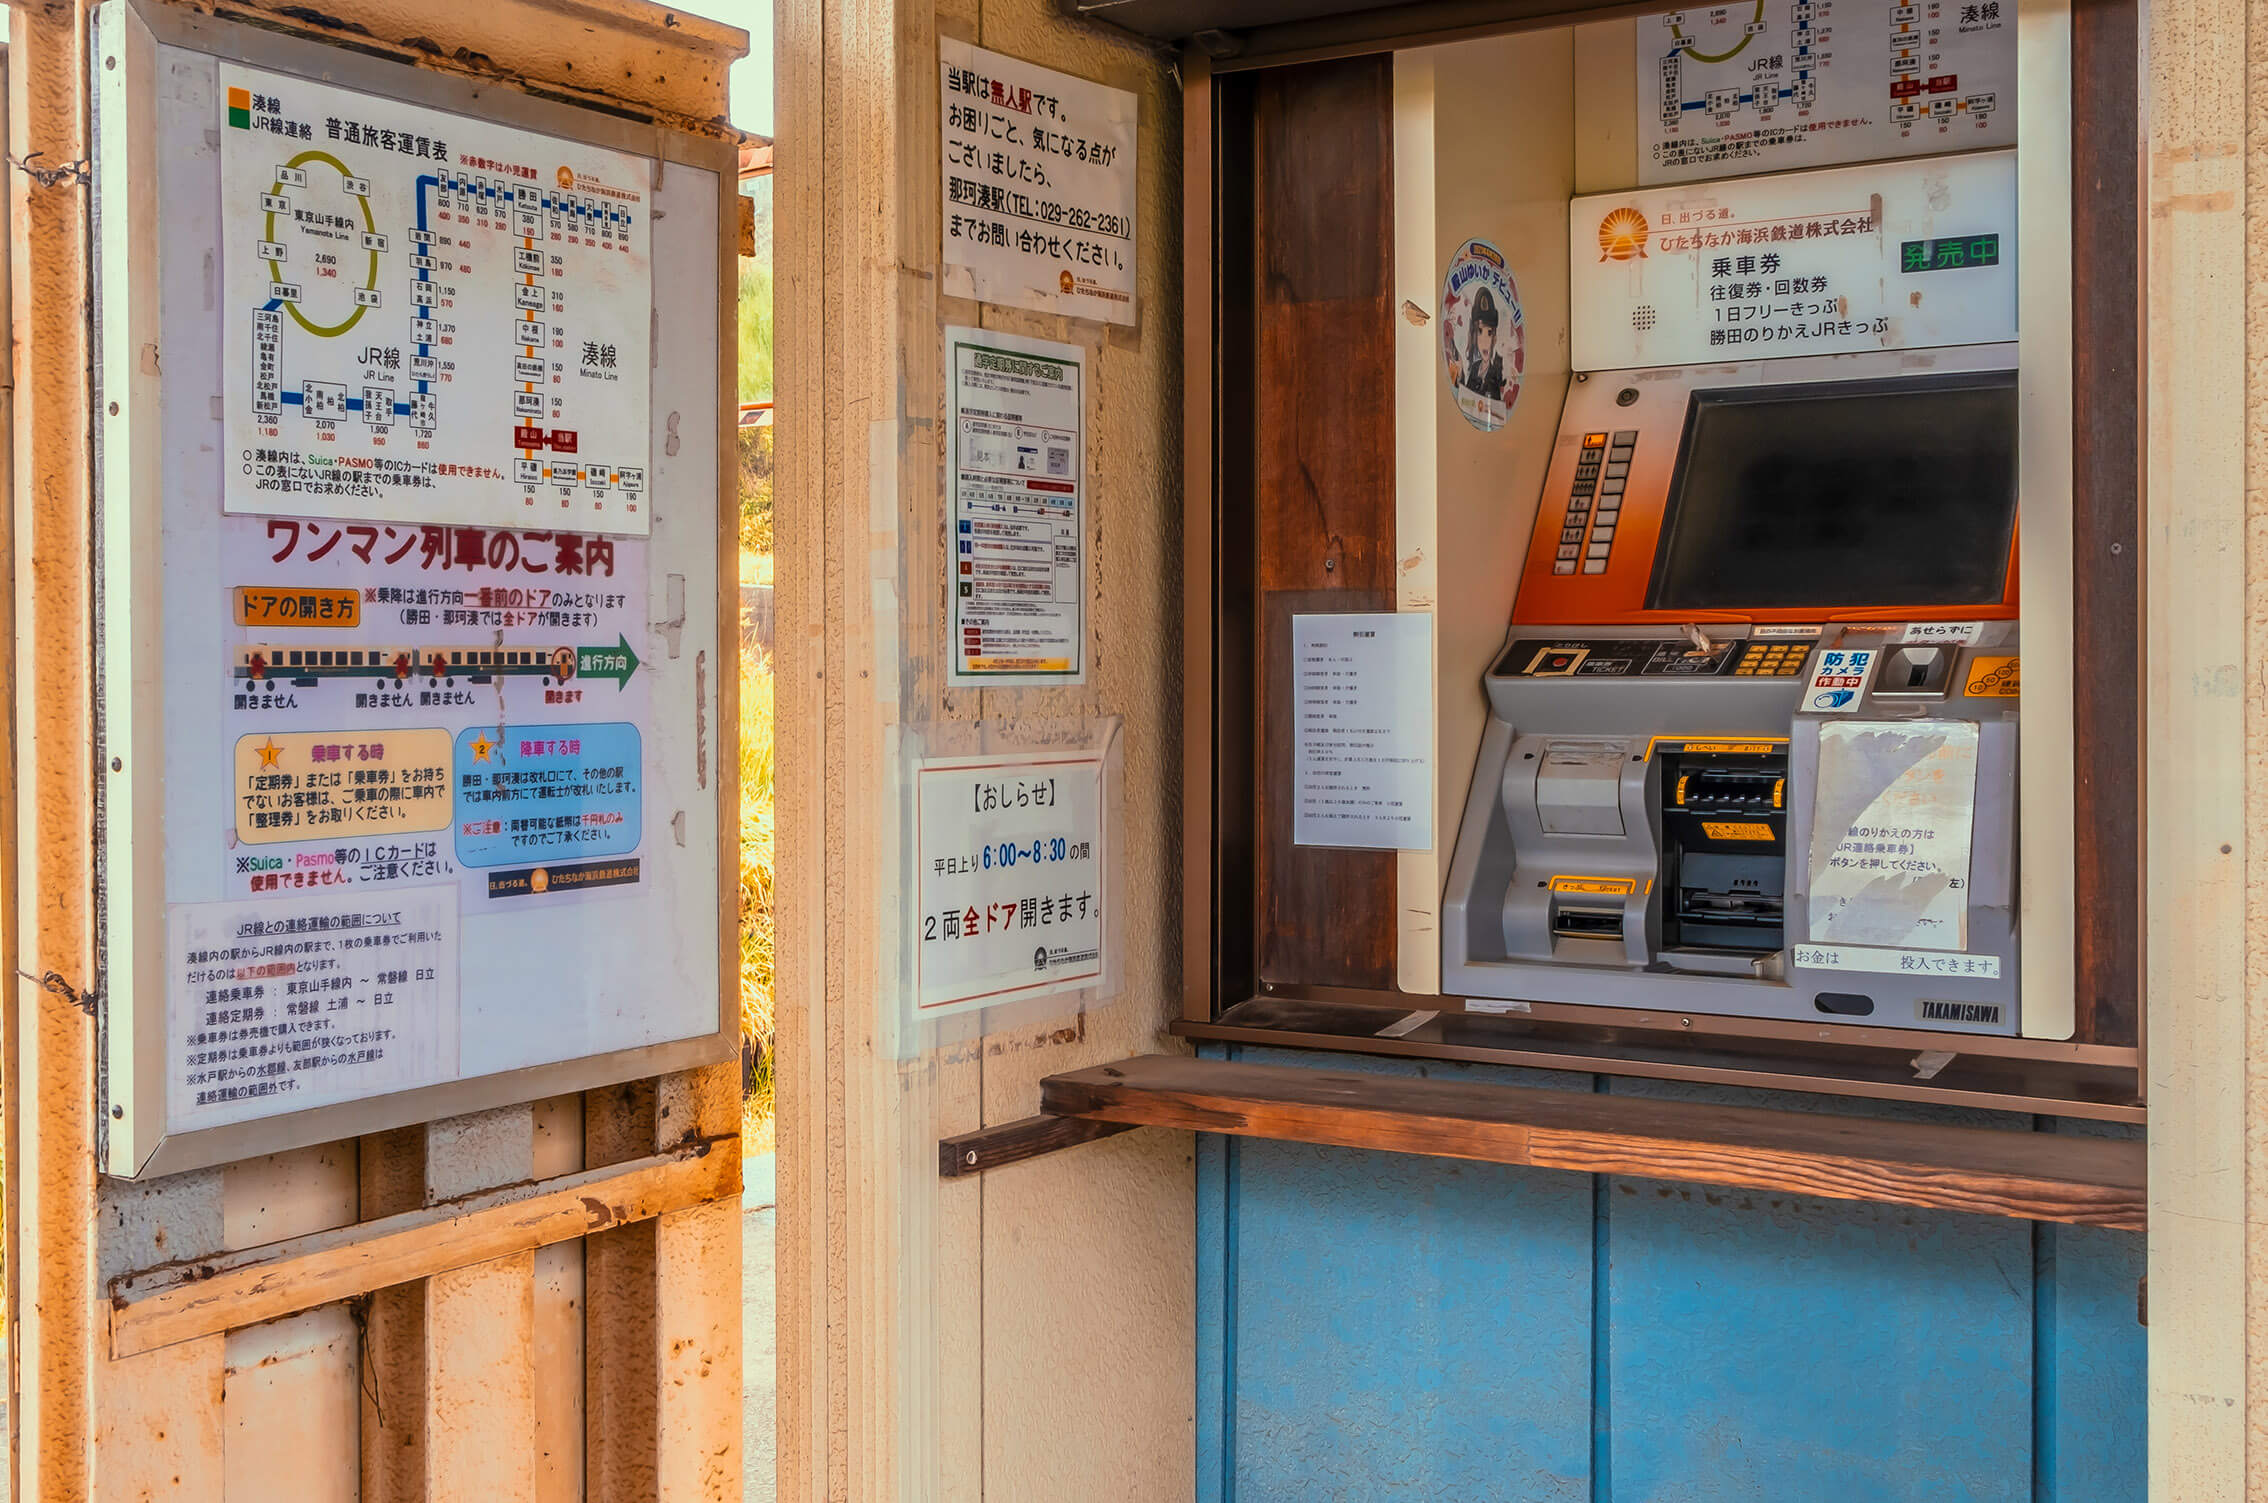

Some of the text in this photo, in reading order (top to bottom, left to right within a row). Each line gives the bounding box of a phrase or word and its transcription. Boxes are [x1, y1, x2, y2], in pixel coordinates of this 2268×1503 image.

[1960, 2, 2000, 23] 湊線
[1748, 55, 1784, 72] JR線
[947, 67, 1067, 122] 当駅は無人駅です。
[252, 94, 282, 115] 湊線
[252, 116, 449, 163] JR線連絡 普通旅客運賃表
[948, 103, 1117, 167] お困りごと、気になる点が
[948, 139, 1052, 188] ございましたら、
[280, 170, 303, 183] 品川
[518, 187, 537, 202] 勝田
[264, 197, 287, 211] 東京
[457, 202, 470, 212] 710
[294, 209, 355, 231] 東京山手線内
[495, 209, 507, 219] 570
[619, 210, 626, 228] 日立
[1661, 207, 1736, 225] 日、出づる道。
[550, 220, 562, 230] 570
[584, 226, 596, 236] 710
[1660, 216, 1875, 252] ひたちなか海浜鉄道株式会社
[261, 245, 284, 257] 上野
[950, 214, 1124, 271] までお問い合わせください。
[550, 256, 563, 265] 350
[1904, 238, 1998, 271] 発売中
[1710, 252, 1781, 278] 乗車券
[273, 286, 298, 299] 日暮里
[438, 286, 456, 296] 1,150
[521, 287, 564, 301] 金上 310
[1709, 277, 1828, 302] 往復券・回数券
[256, 313, 279, 323] 三河島
[256, 333, 279, 343] 北千住
[438, 324, 456, 334] 1,370
[1709, 315, 1890, 346] 勝田のりかえJRきっぷ
[357, 346, 401, 370] JR線
[581, 341, 617, 368] 湊線
[260, 362, 275, 371] 金町
[438, 361, 456, 371] 1,550
[551, 363, 563, 372] 150
[579, 368, 618, 382] Minato Line
[260, 372, 275, 381] 松戸
[363, 371, 395, 383] JR Line
[440, 373, 453, 382] 770
[256, 381, 278, 391] 北松戸
[256, 401, 278, 411] 新松戸
[304, 384, 313, 415] 北小金
[326, 396, 335, 407] 柏
[337, 392, 345, 413] 北柏
[375, 391, 383, 422] 天王台
[384, 397, 393, 417] 取手
[551, 397, 563, 407] 150
[257, 415, 278, 425] 2,360
[427, 401, 436, 422] 牛久
[315, 420, 336, 430] 2,070
[316, 432, 336, 442] 1,030
[414, 430, 433, 439] 1,720
[255, 478, 384, 499] JRの窓口でお求めください。
[523, 485, 604, 499] 150 150 150
[267, 519, 614, 577] ワンマン列車のご案内
[243, 595, 354, 620] ドアの開き方
[1909, 625, 1974, 635] あせらずに
[580, 655, 628, 672] 進行方向
[1823, 652, 1870, 667] 防犯
[1820, 666, 1865, 675] カメラ
[1818, 677, 1860, 687] 作動中
[234, 690, 583, 710] 開きません 開きません 開きません 開きます
[311, 743, 385, 763] 乗車する時
[479, 739, 581, 758] 2 降車する時
[248, 767, 445, 791] 「定期券」または「乗車券」をお持ち
[243, 785, 446, 810] でないお客様は、ご乗車の際に車内で
[975, 778, 1055, 813] 【おしらせ】
[248, 806, 407, 829] 「整理券」をお取りください。
[511, 829, 611, 847] ですのでご了承ください。
[1829, 857, 1942, 873] ボタンを押してください。
[236, 911, 402, 938] JR線との連絡運輸の範囲について
[186, 958, 341, 984] だけるのは以下の範囲内となります。
[1796, 950, 1999, 976] お金は 投入できます。
[205, 967, 435, 1005] 連絡乗車券 東京山手線内 常磐線 日立
[205, 992, 394, 1027] 連絡定期券 常磐線 土浦 日立
[1921, 1001, 1999, 1024] TAKAMISAWA
[196, 1078, 301, 1106] 連絡運輸の範囲外です。
